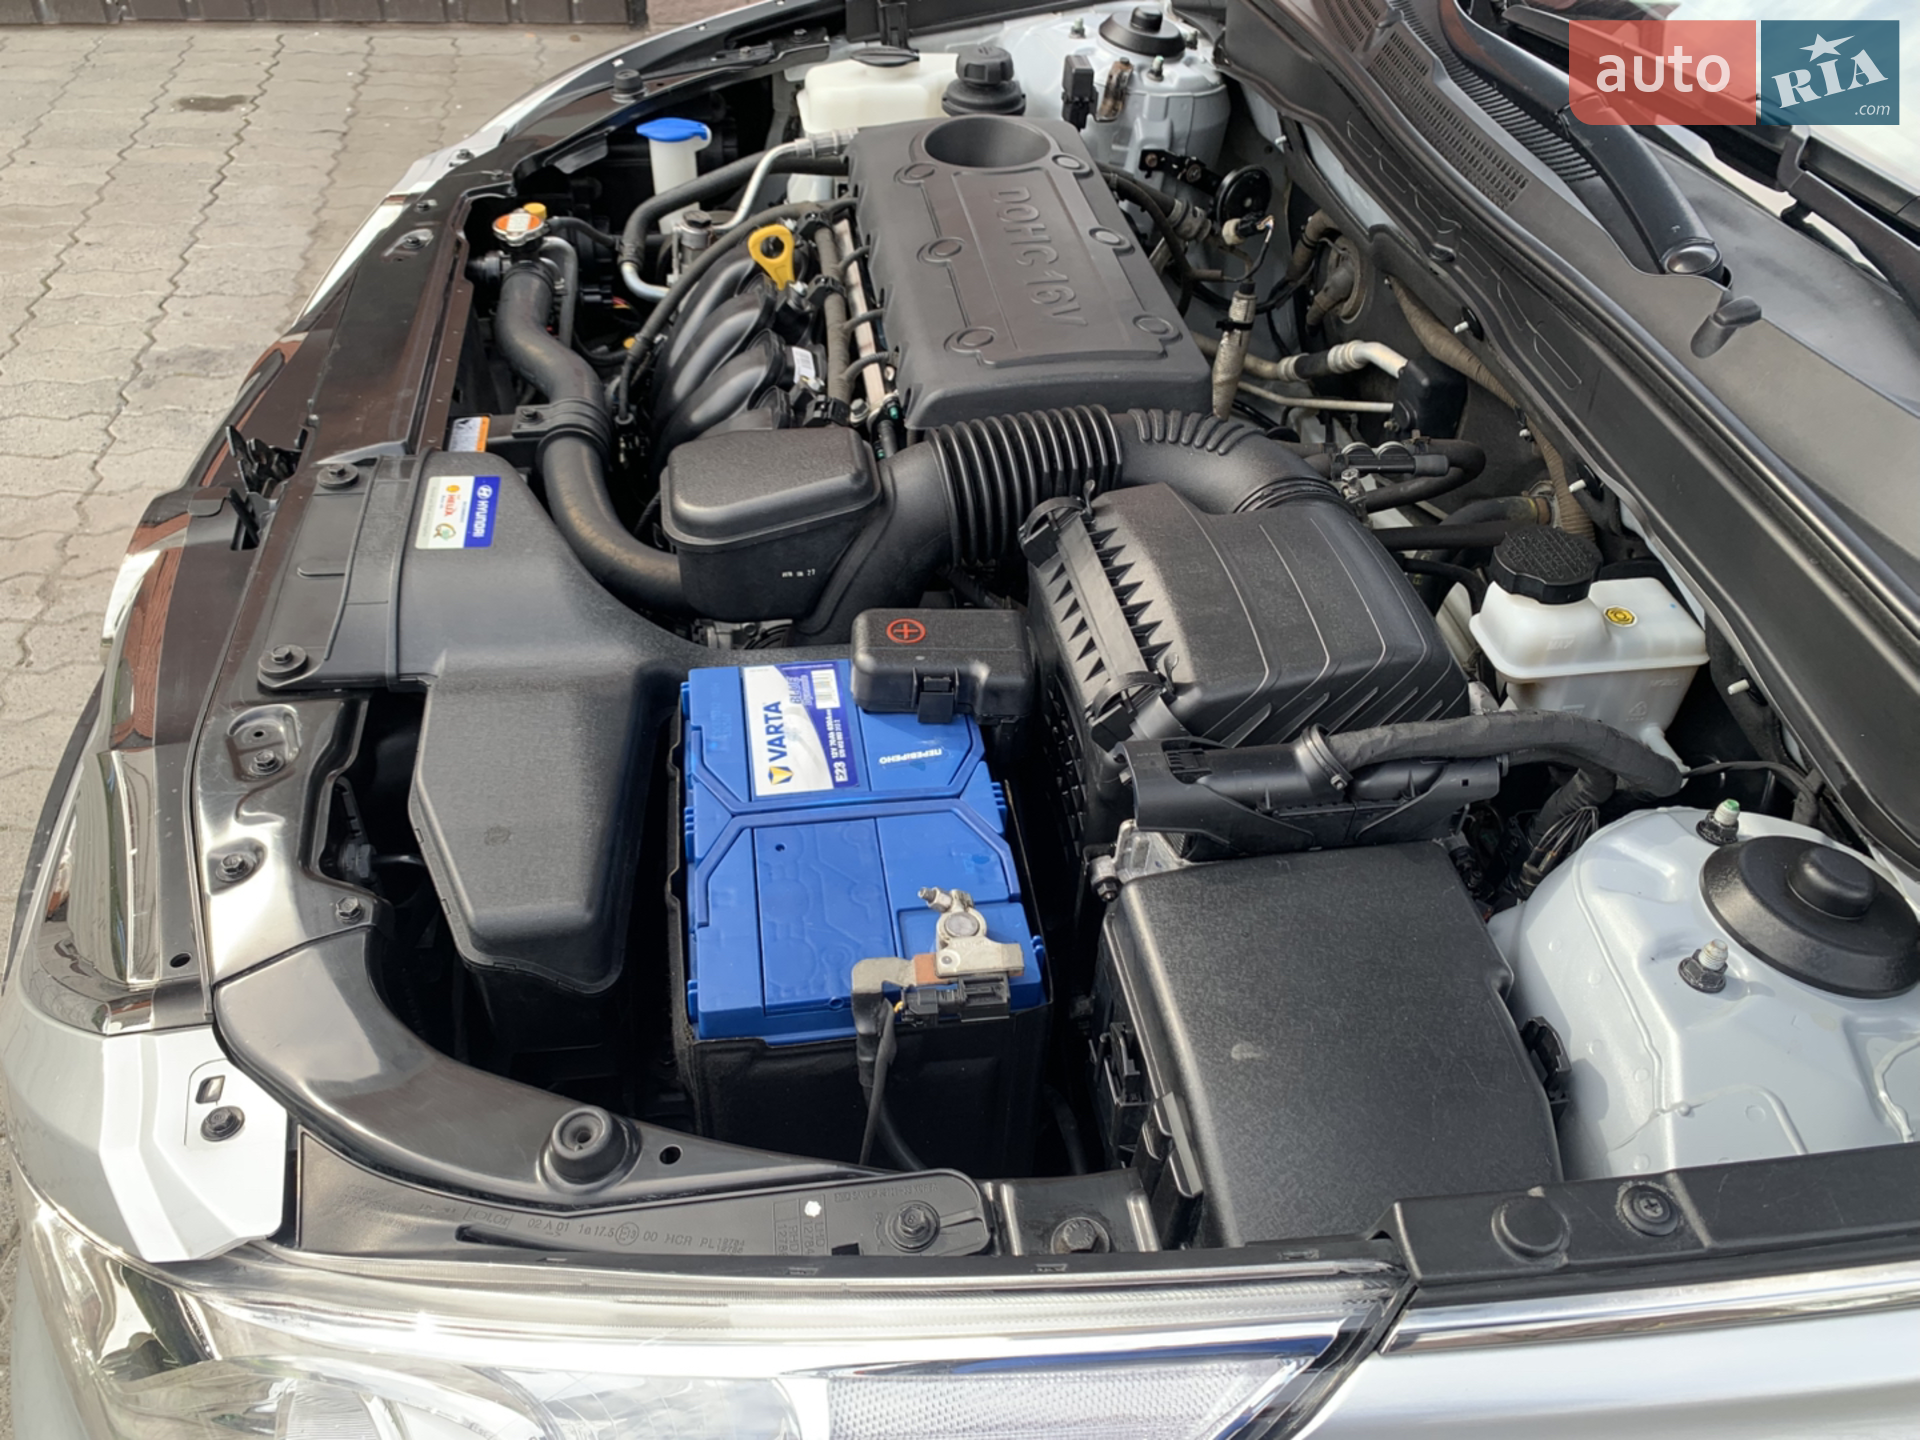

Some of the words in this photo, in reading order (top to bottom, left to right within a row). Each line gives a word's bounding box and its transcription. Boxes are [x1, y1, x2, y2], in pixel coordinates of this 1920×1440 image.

[993, 186, 1060, 267] DOHC
[1023, 270, 1089, 327] 16V
[472, 500, 489, 538] HYUNDAI
[787, 675, 801, 705] BLUE
[763, 701, 787, 763] VARTA
[879, 748, 943, 764] ПЕРЕВІРЕНО
[833, 761, 848, 783] E23
[527, 1218, 542, 1230] 02
[594, 1225, 615, 1238] 17.5
[643, 1230, 658, 1243] 00
[664, 1232, 693, 1247] HCR
[699, 1237, 715, 1250] PL
[789, 1224, 799, 1253] RHD
[815, 1221, 825, 1247] LHD
